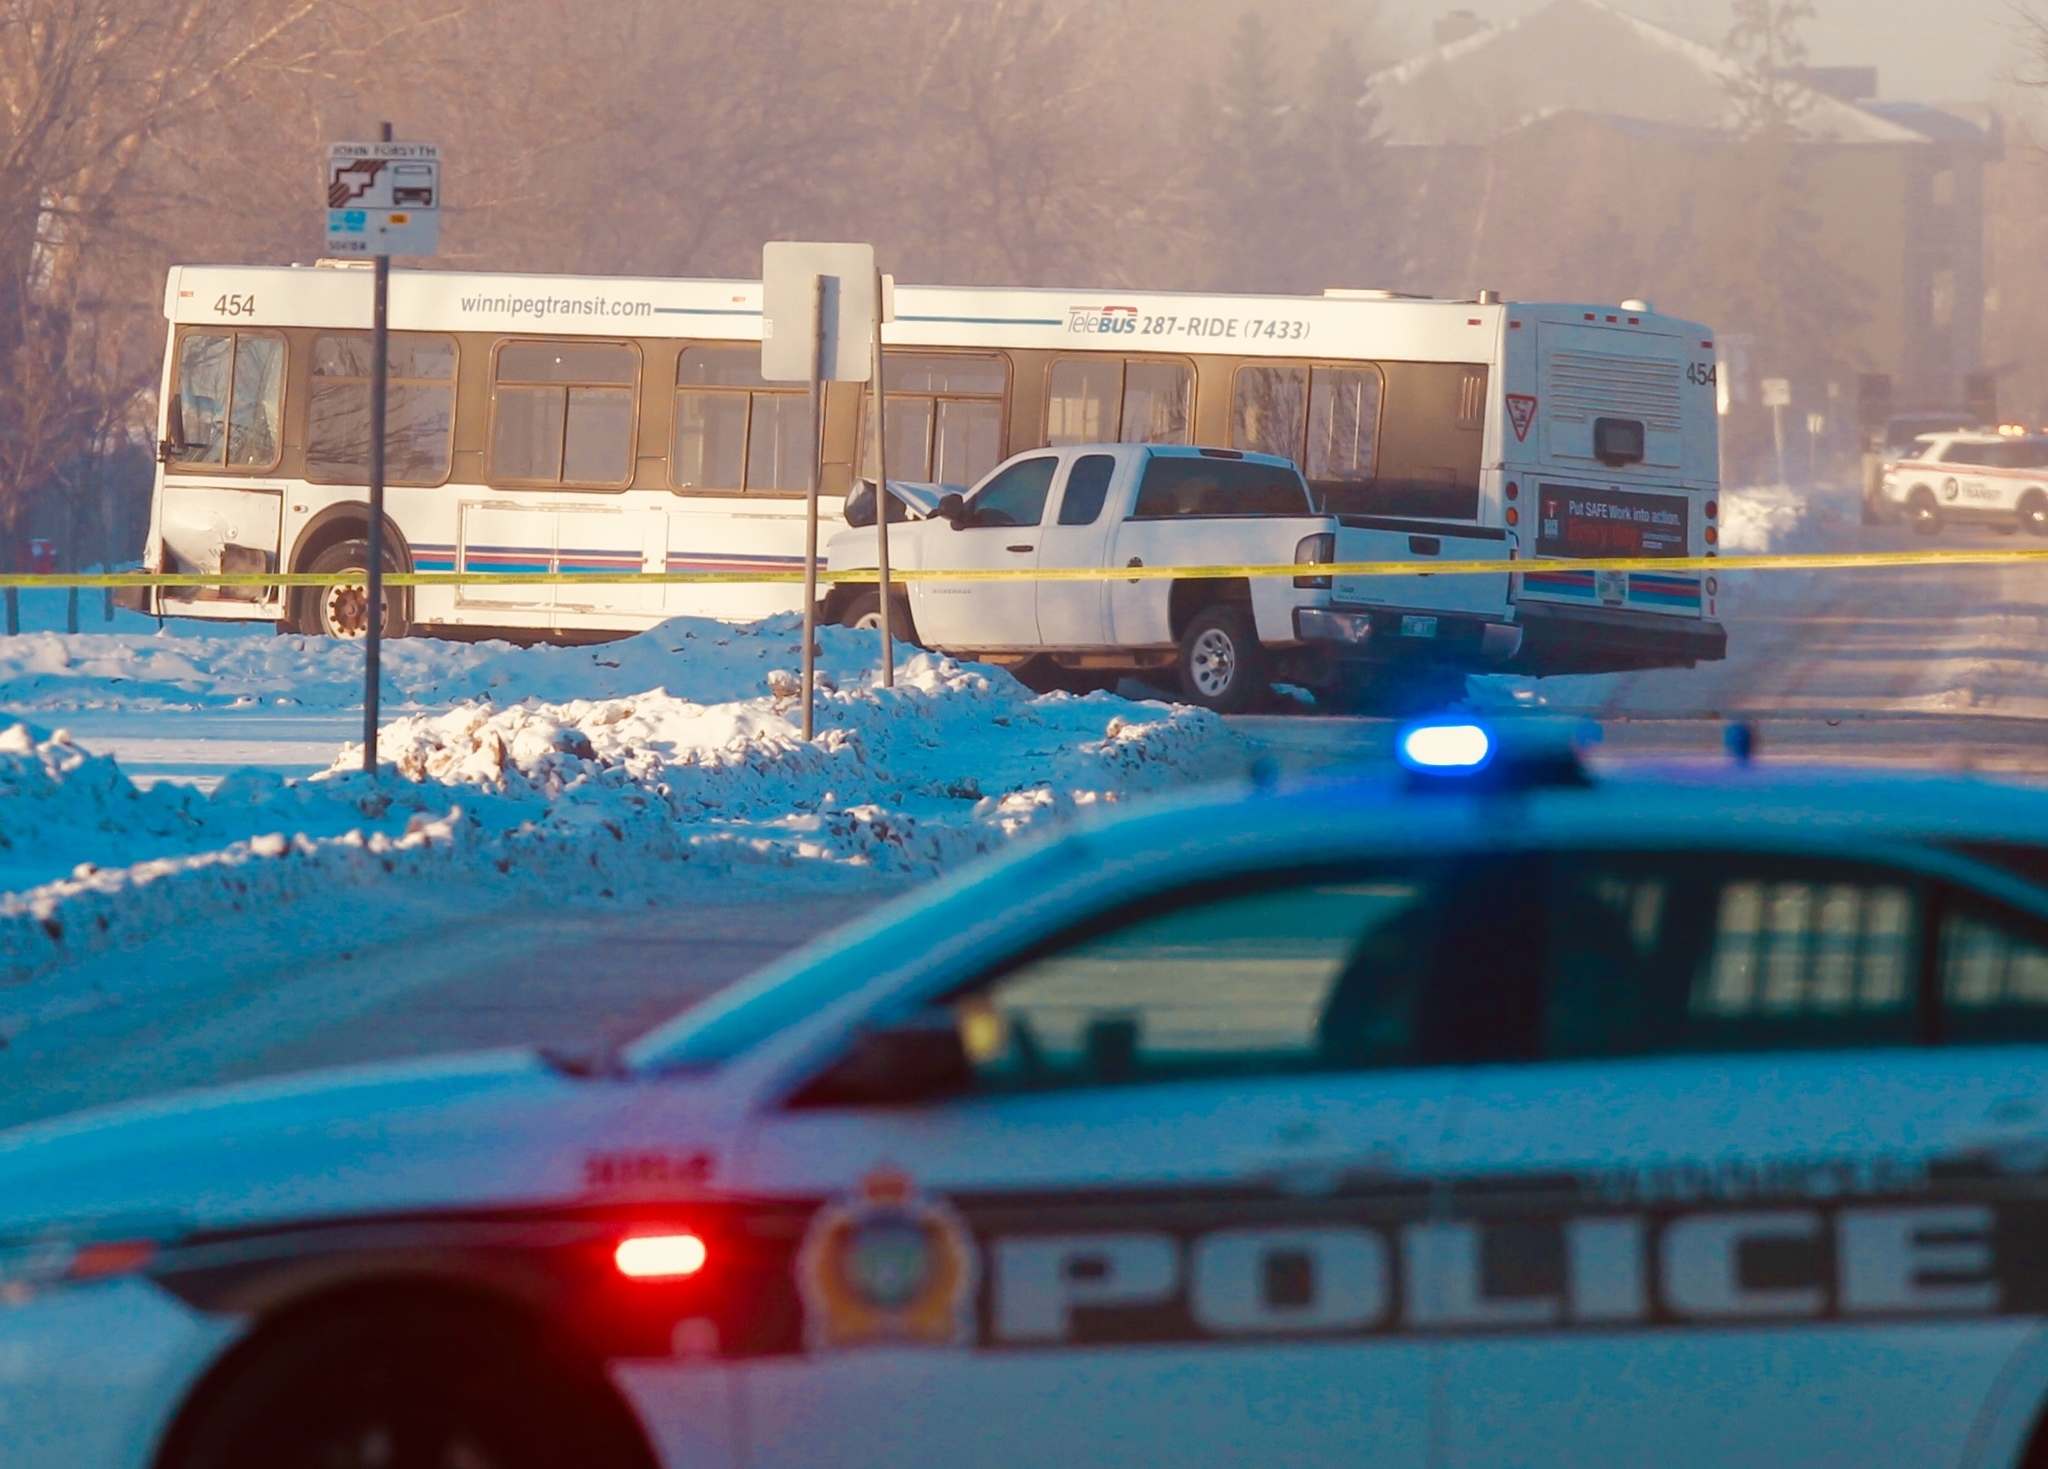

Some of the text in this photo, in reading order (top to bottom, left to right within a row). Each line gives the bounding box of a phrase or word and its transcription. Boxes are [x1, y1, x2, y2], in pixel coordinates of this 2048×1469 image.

[213, 294, 255, 316] 454
[461, 294, 652, 318] winnipegtransit.com
[1067, 311, 1311, 340] TeleBUS 287-RIDE (7433)
[1686, 362, 1717, 387] 454
[1585, 502, 1608, 518] SAFE
[995, 1205, 1997, 1342] POLICE
